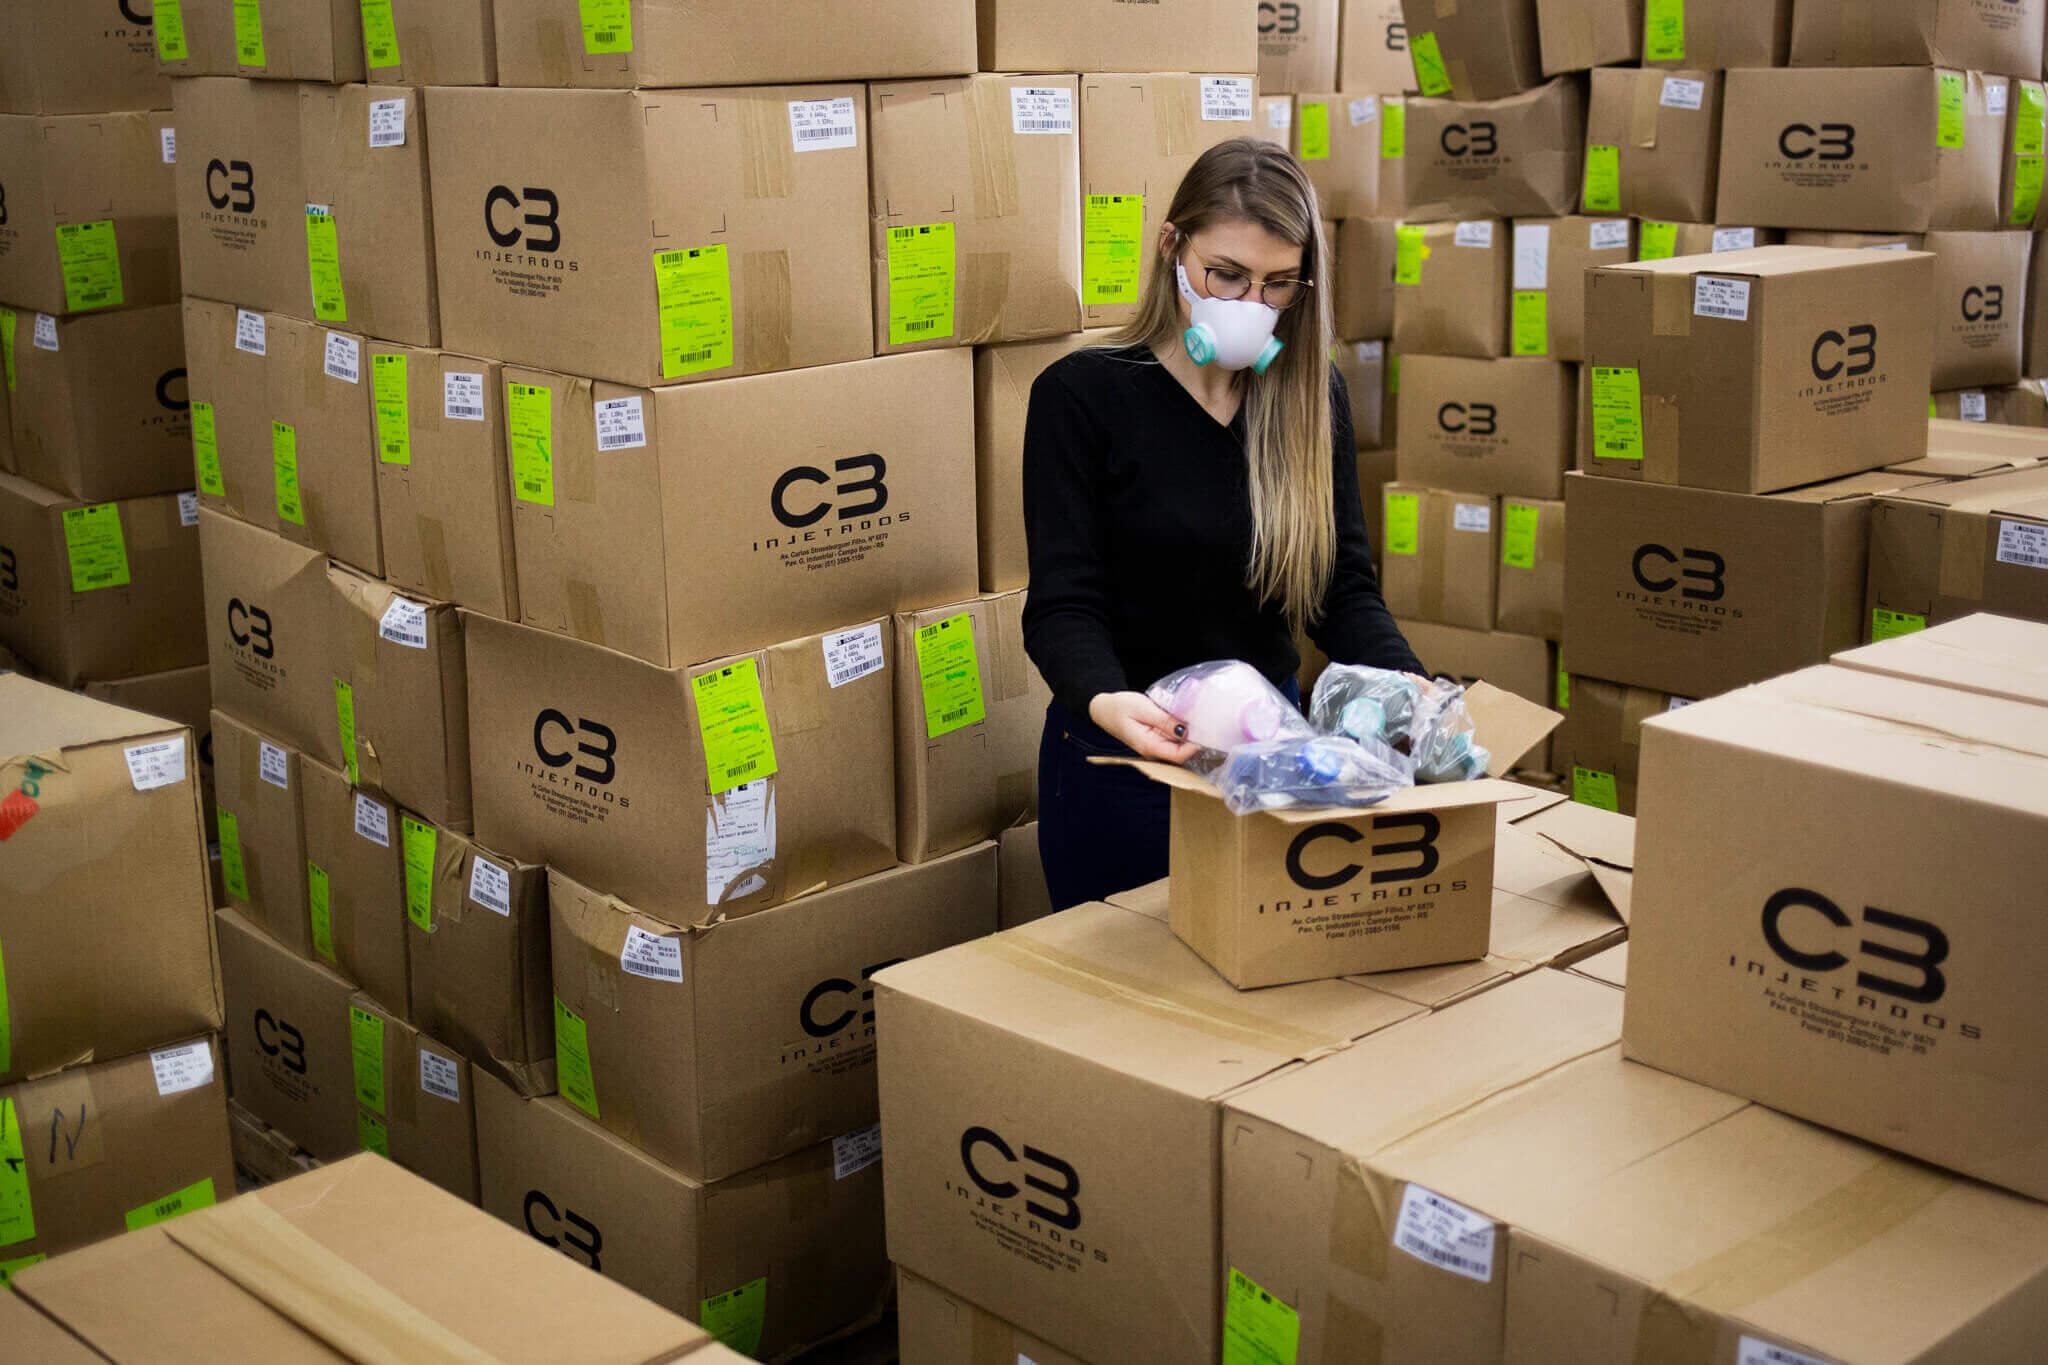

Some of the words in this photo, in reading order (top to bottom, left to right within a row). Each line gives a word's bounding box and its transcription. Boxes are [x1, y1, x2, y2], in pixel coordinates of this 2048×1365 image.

[476, 250, 579, 272] INJETADOS
[753, 512, 910, 551] INJETADOS
[517, 761, 629, 808] INJETADOS
[1259, 881, 1467, 914] INJETADOS
[1730, 955, 1982, 1039] INJETADOS
[946, 1180, 1108, 1263] INJETADOS
